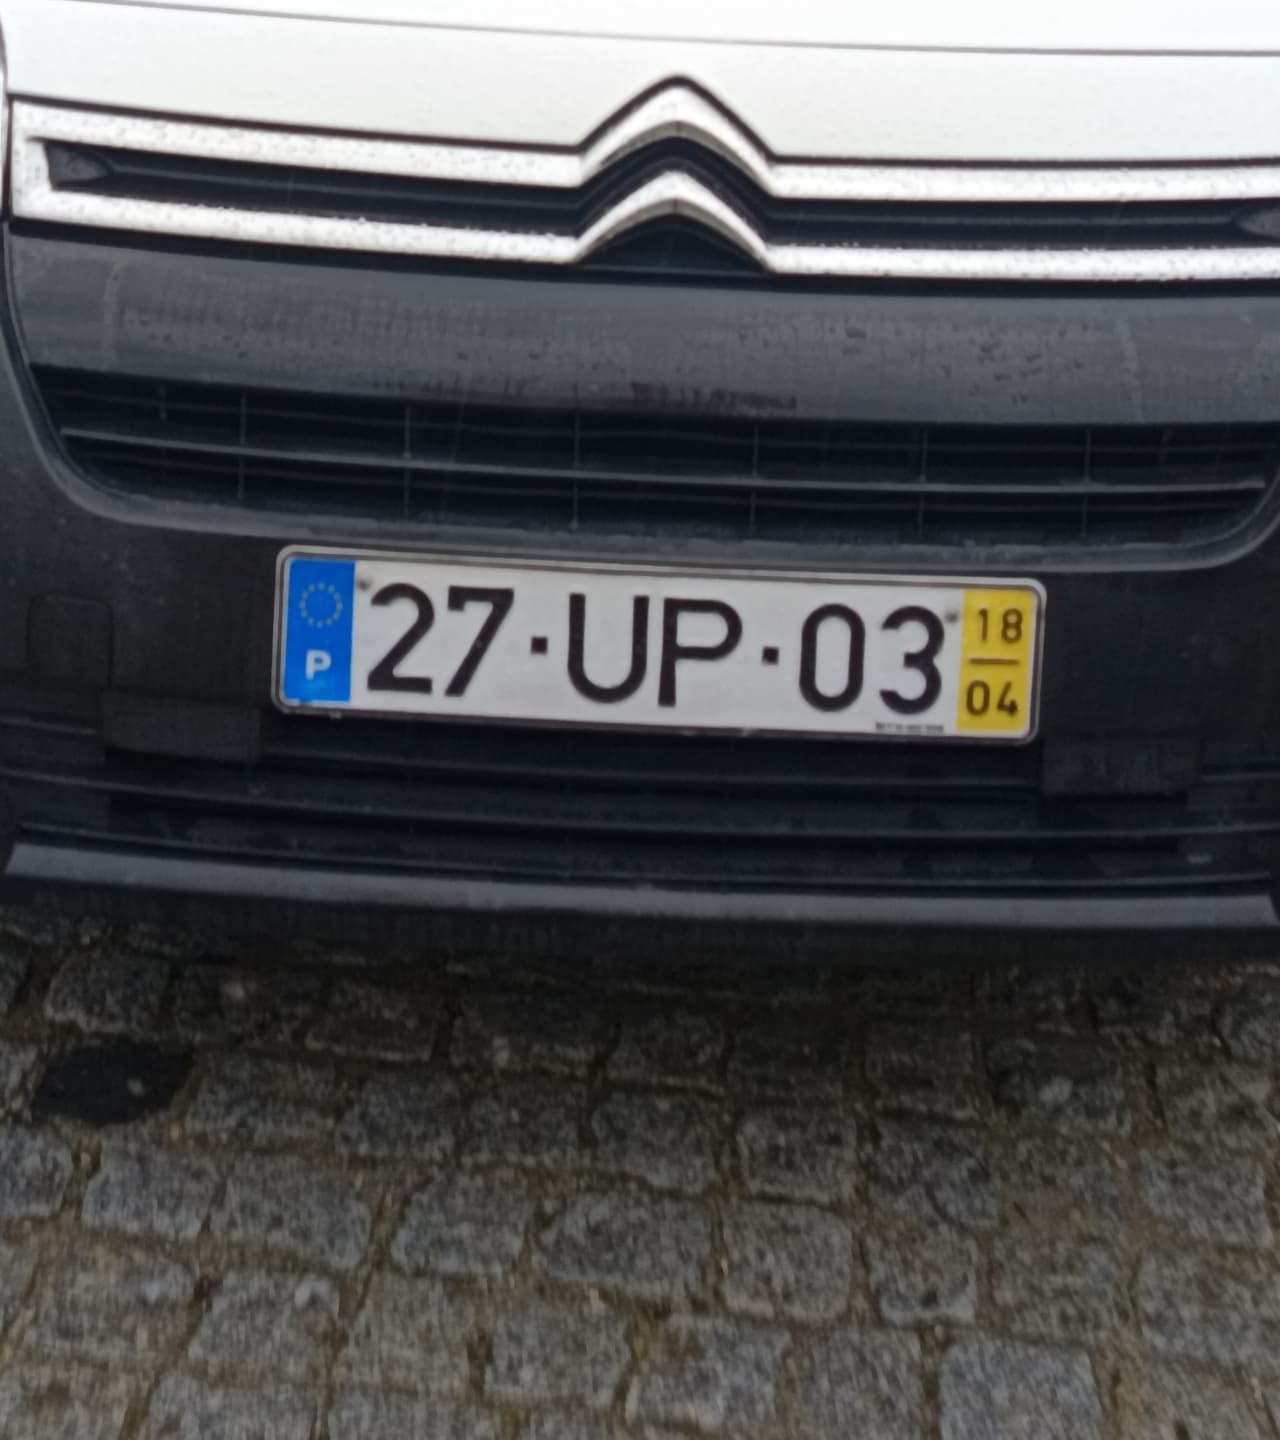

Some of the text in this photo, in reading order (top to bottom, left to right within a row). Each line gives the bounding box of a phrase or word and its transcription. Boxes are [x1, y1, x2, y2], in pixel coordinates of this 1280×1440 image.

[977, 608, 1024, 644] 18
[305, 648, 332, 680] P
[965, 680, 1019, 717] 04
